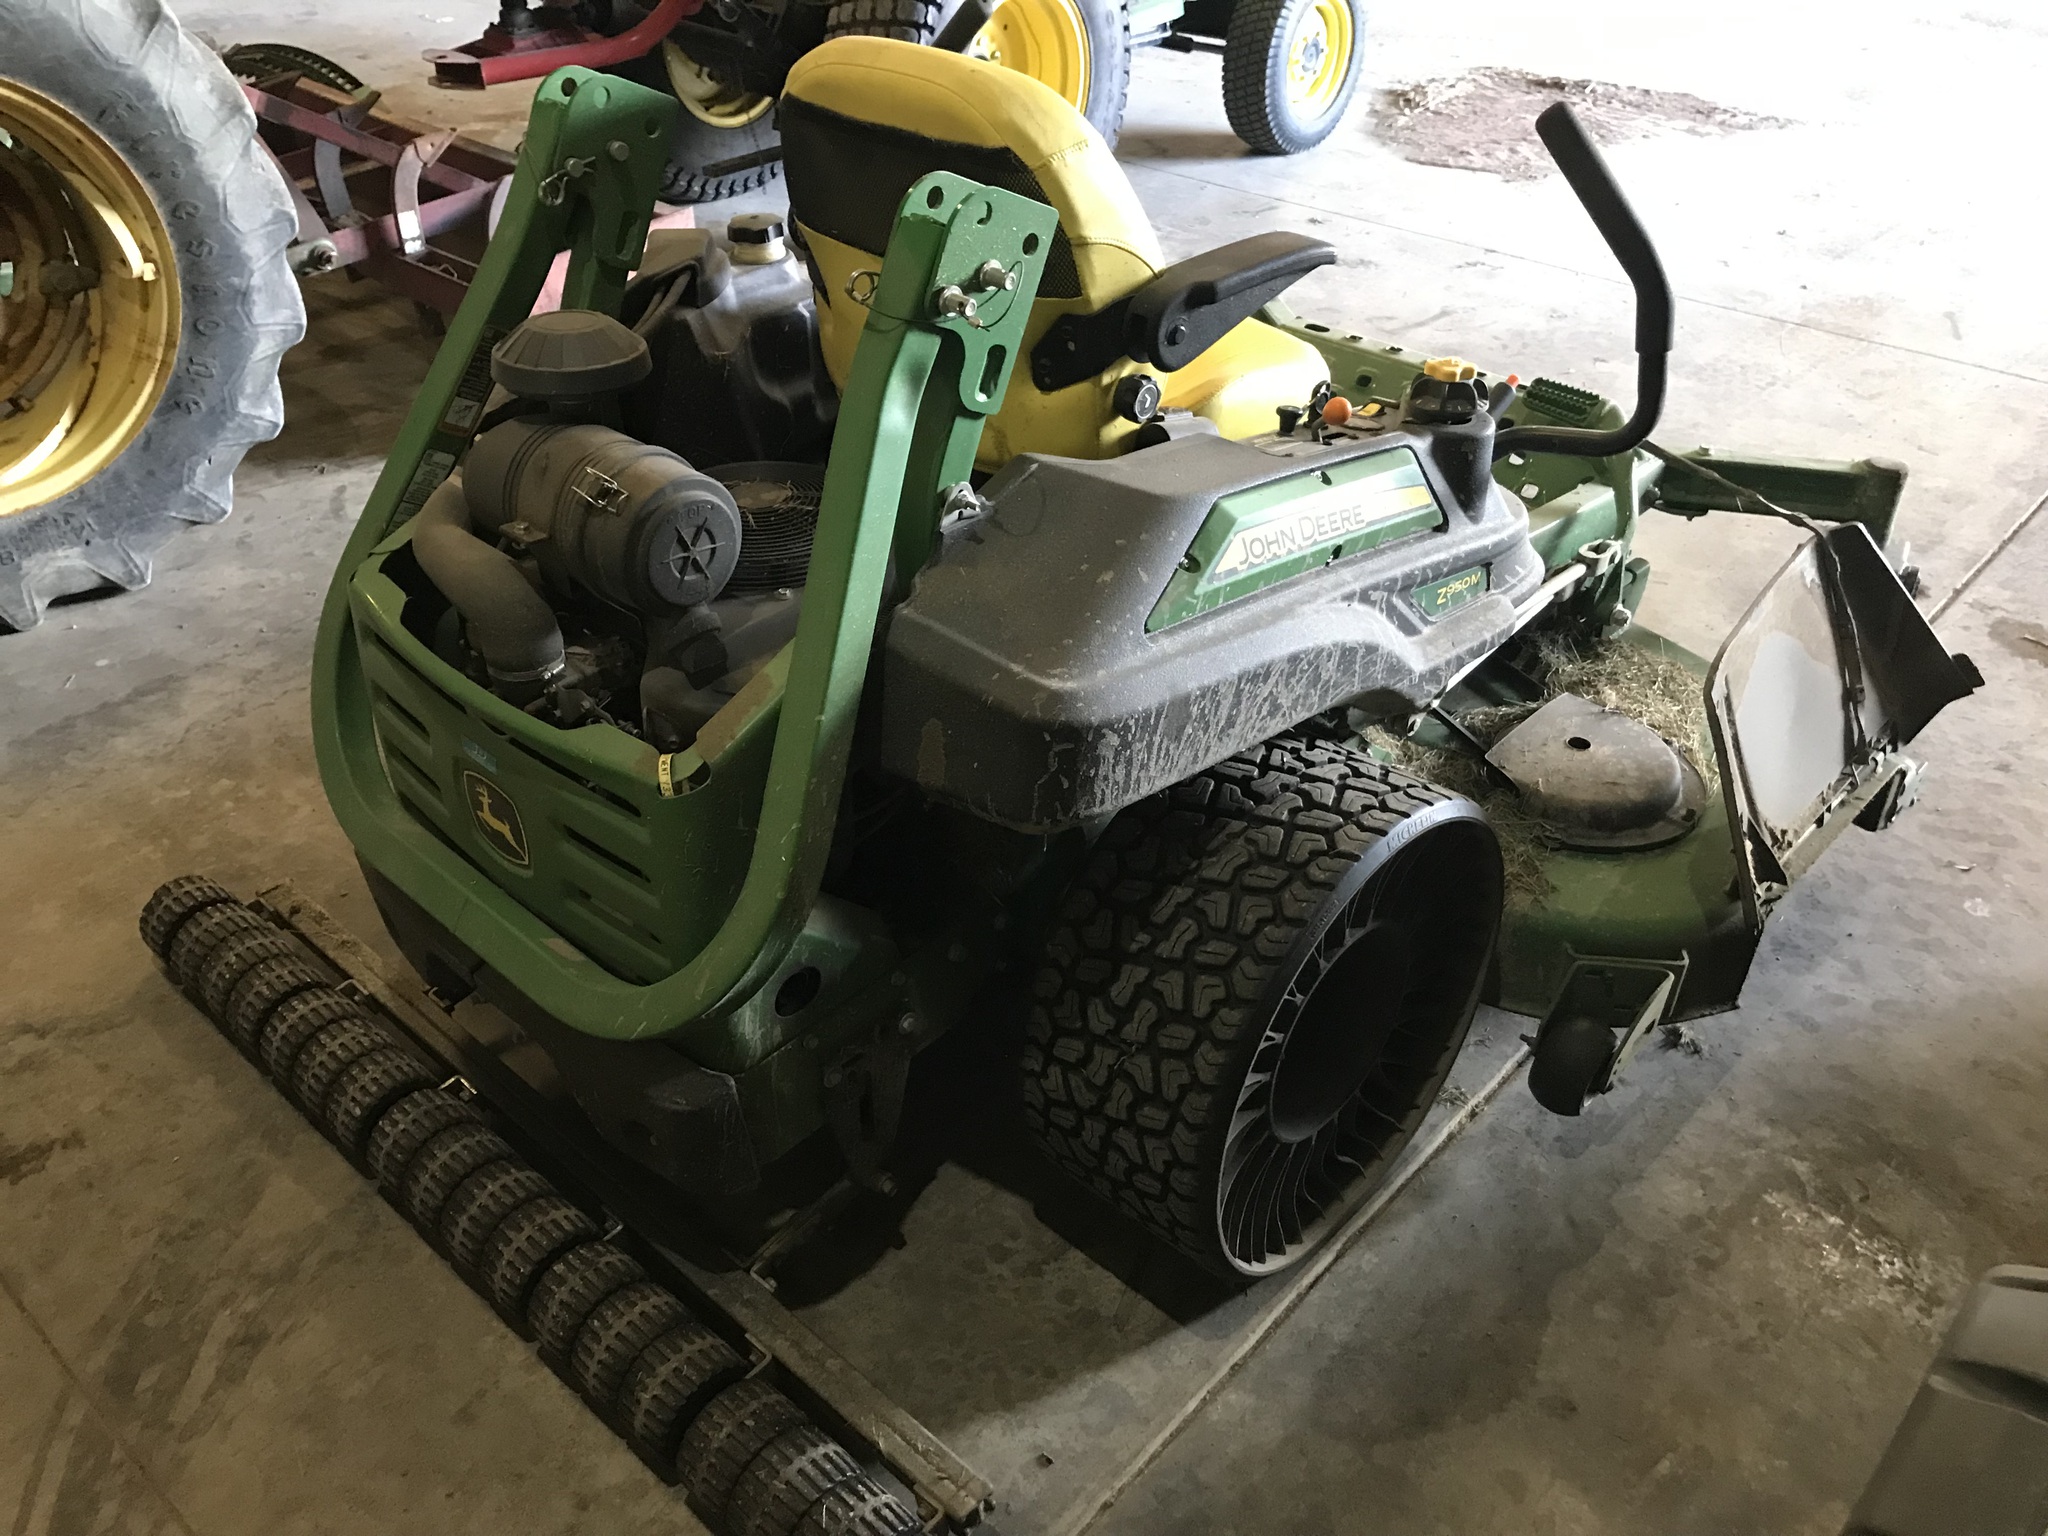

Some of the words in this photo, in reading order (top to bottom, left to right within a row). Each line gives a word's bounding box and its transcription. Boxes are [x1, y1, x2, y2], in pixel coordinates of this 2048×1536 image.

[1239, 526, 1297, 566] JOHN
[1298, 505, 1365, 542] DEERE
[1436, 571, 1482, 605] Z950M
[1386, 810, 1437, 853] MICHELIN
